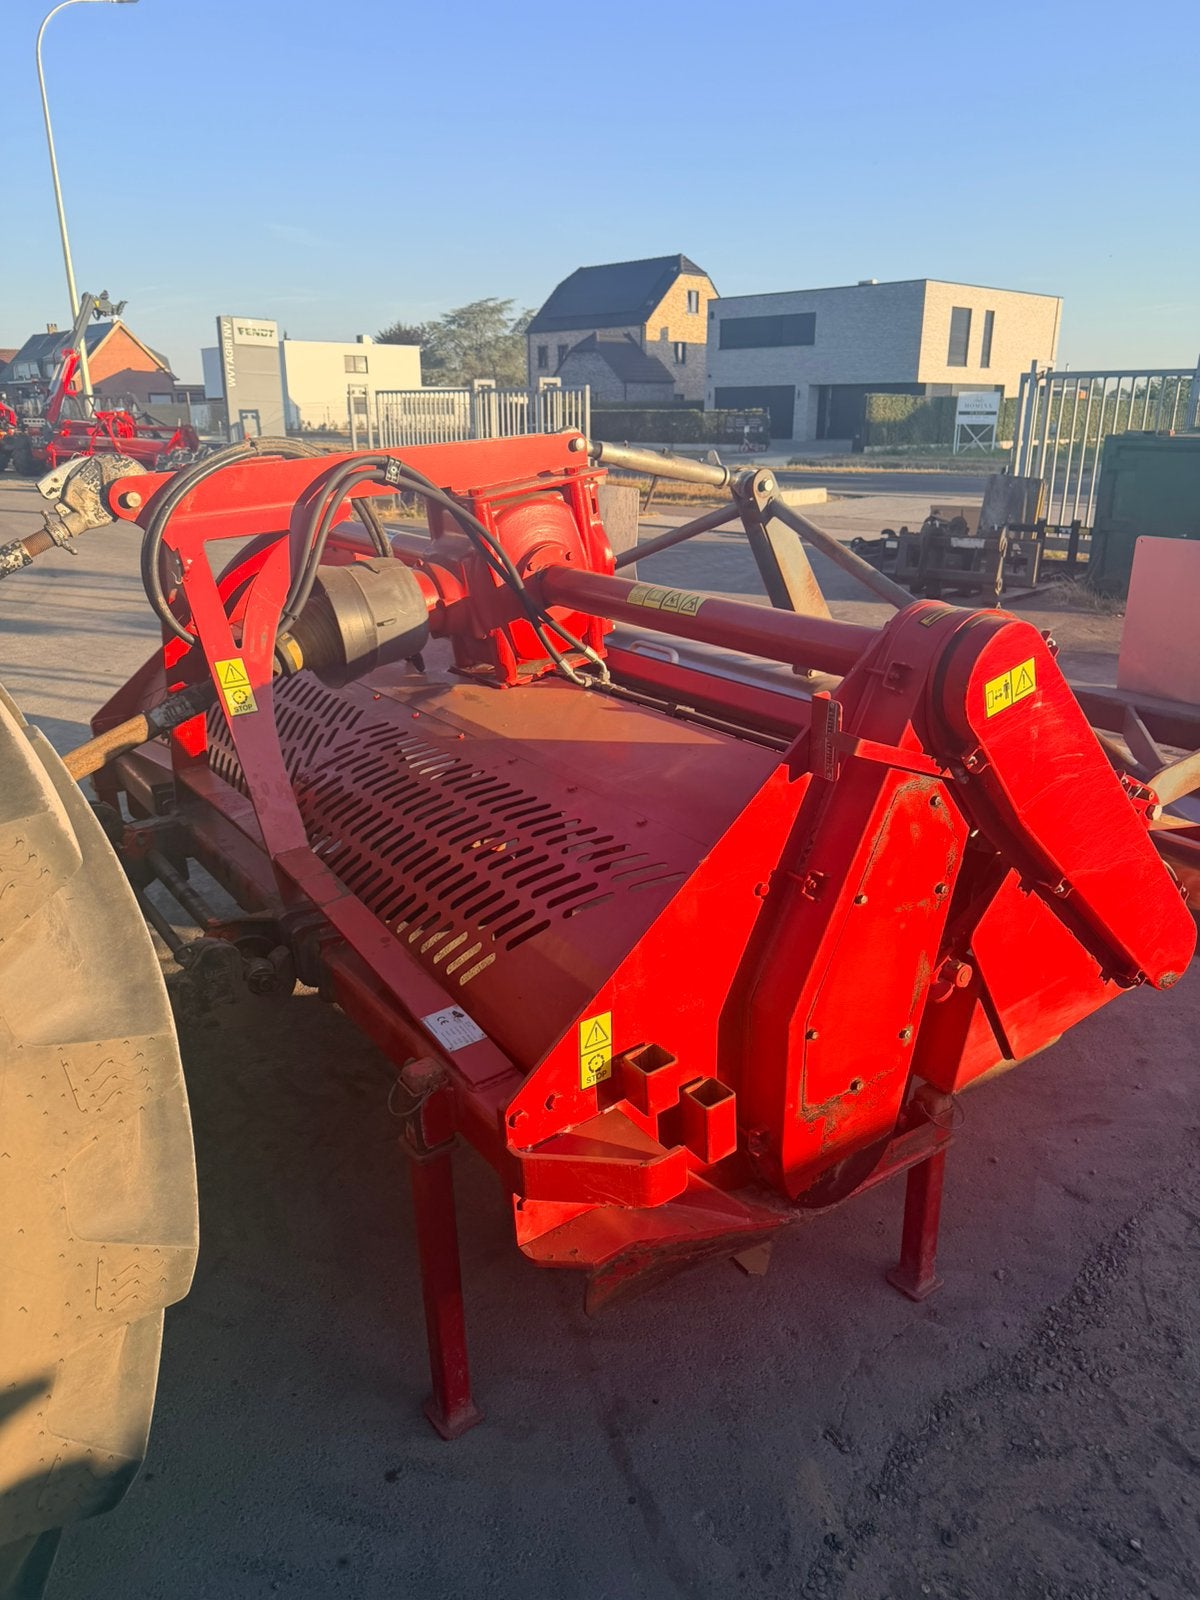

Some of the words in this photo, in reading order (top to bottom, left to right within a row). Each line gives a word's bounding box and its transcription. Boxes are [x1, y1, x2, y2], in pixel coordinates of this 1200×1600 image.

[223, 321, 232, 337] NV
[237, 327, 275, 338] FENDT
[225, 340, 235, 364] AGRI
[227, 364, 237, 387] WVT
[234, 704, 253, 713] STOP
[586, 1069, 607, 1084] STOP
